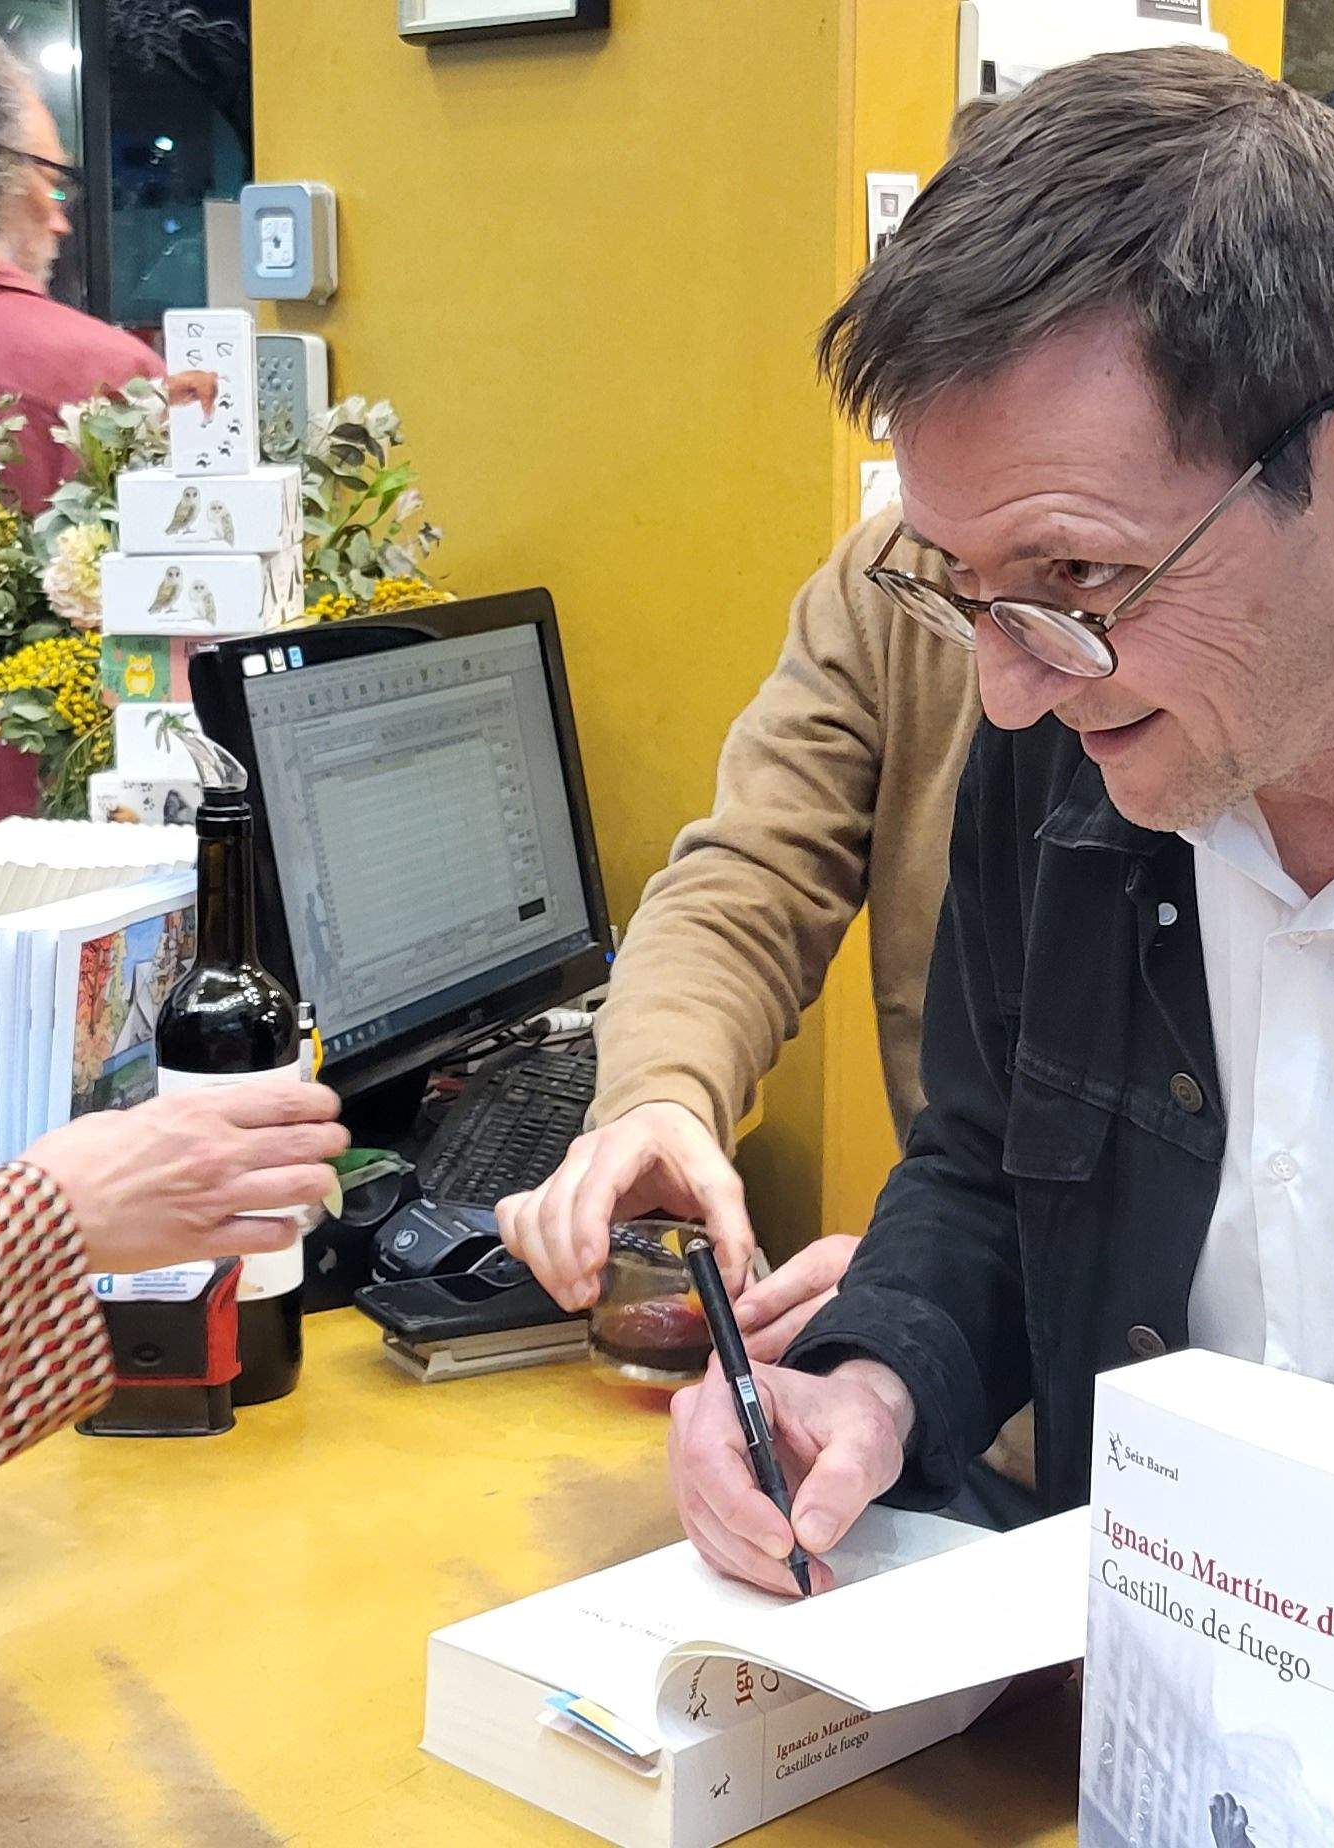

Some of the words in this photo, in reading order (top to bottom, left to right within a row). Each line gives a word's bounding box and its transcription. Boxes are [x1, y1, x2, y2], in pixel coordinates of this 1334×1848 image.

[1124, 1446, 1145, 1468] Seix
[1147, 1456, 1179, 1482] Barral
[1103, 1509, 1184, 1571] Ignacio
[1190, 1551, 1310, 1626] Martínez
[1101, 1558, 1194, 1630] Castillos
[1201, 1608, 1231, 1645] de
[1238, 1624, 1312, 1683] fuego
[776, 1750, 822, 1780] Castillos
[825, 1743, 837, 1759] de
[840, 1731, 869, 1752] fuego
[777, 1731, 819, 1760] Ignacio
